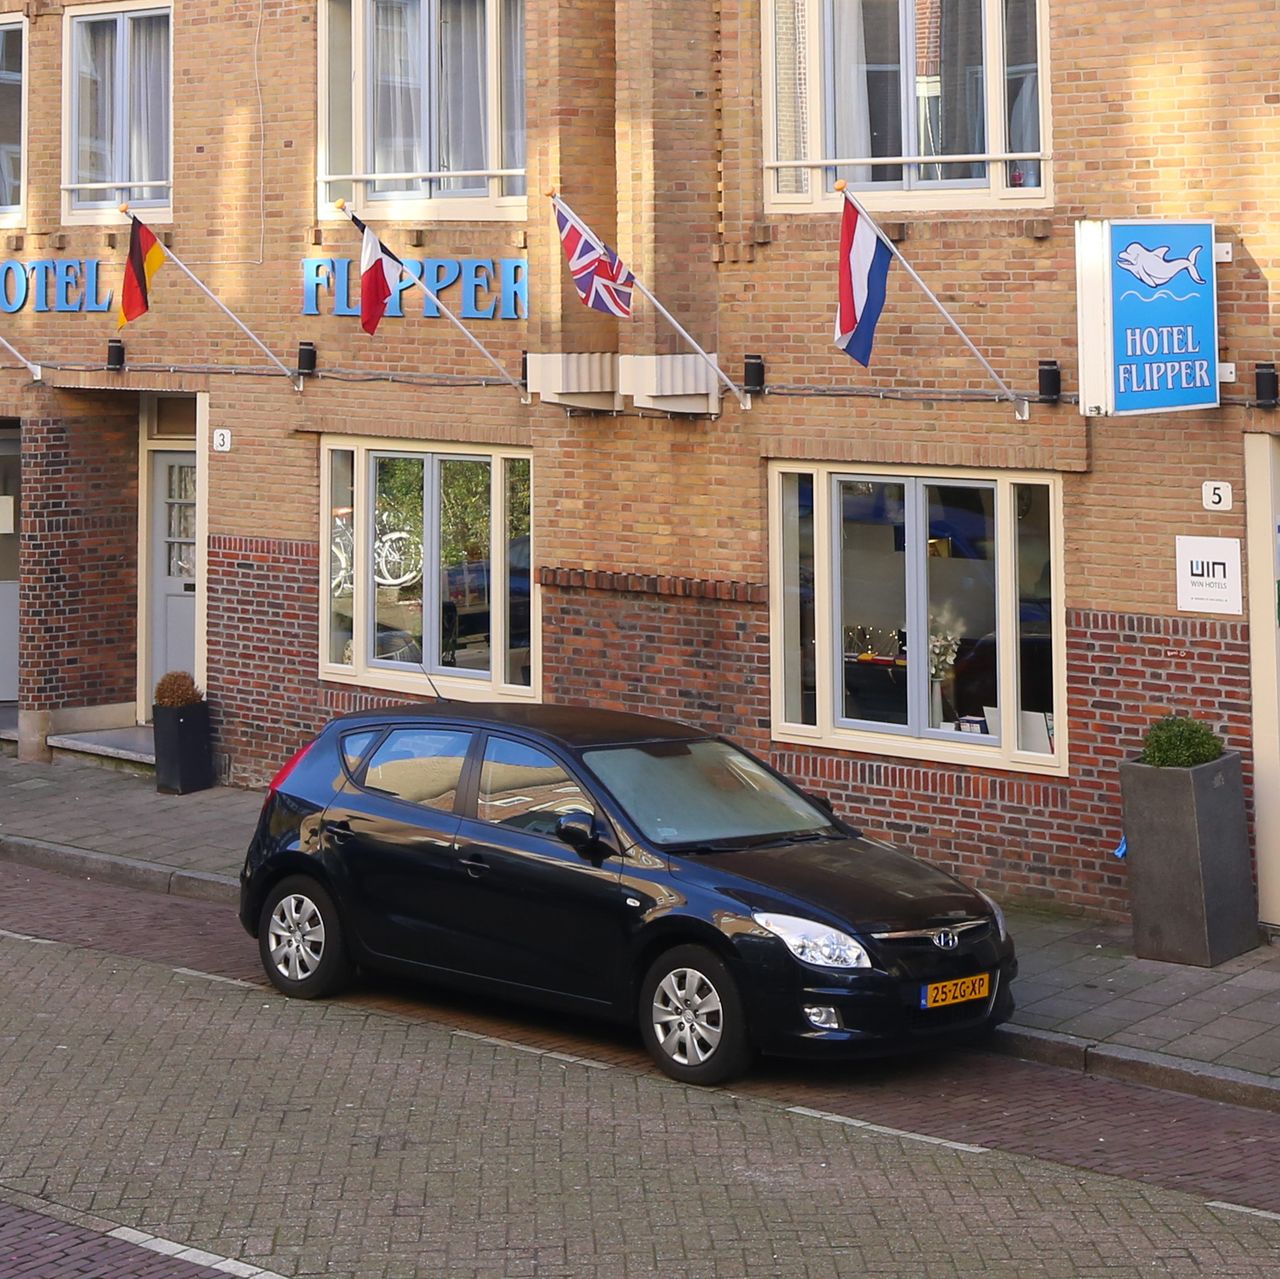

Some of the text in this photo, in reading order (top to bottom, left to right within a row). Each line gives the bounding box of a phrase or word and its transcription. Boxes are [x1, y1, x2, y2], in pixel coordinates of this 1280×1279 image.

[301, 258, 529, 320] FLPPER
[1125, 325, 1200, 357] HOTEL
[1118, 359, 1211, 393] FLIPPER
[218, 432, 225, 447] 3
[1211, 487, 1222, 505] 5
[1190, 580, 1227, 589] WIN HOTELS
[932, 978, 985, 1004] 25-ZG-XP
